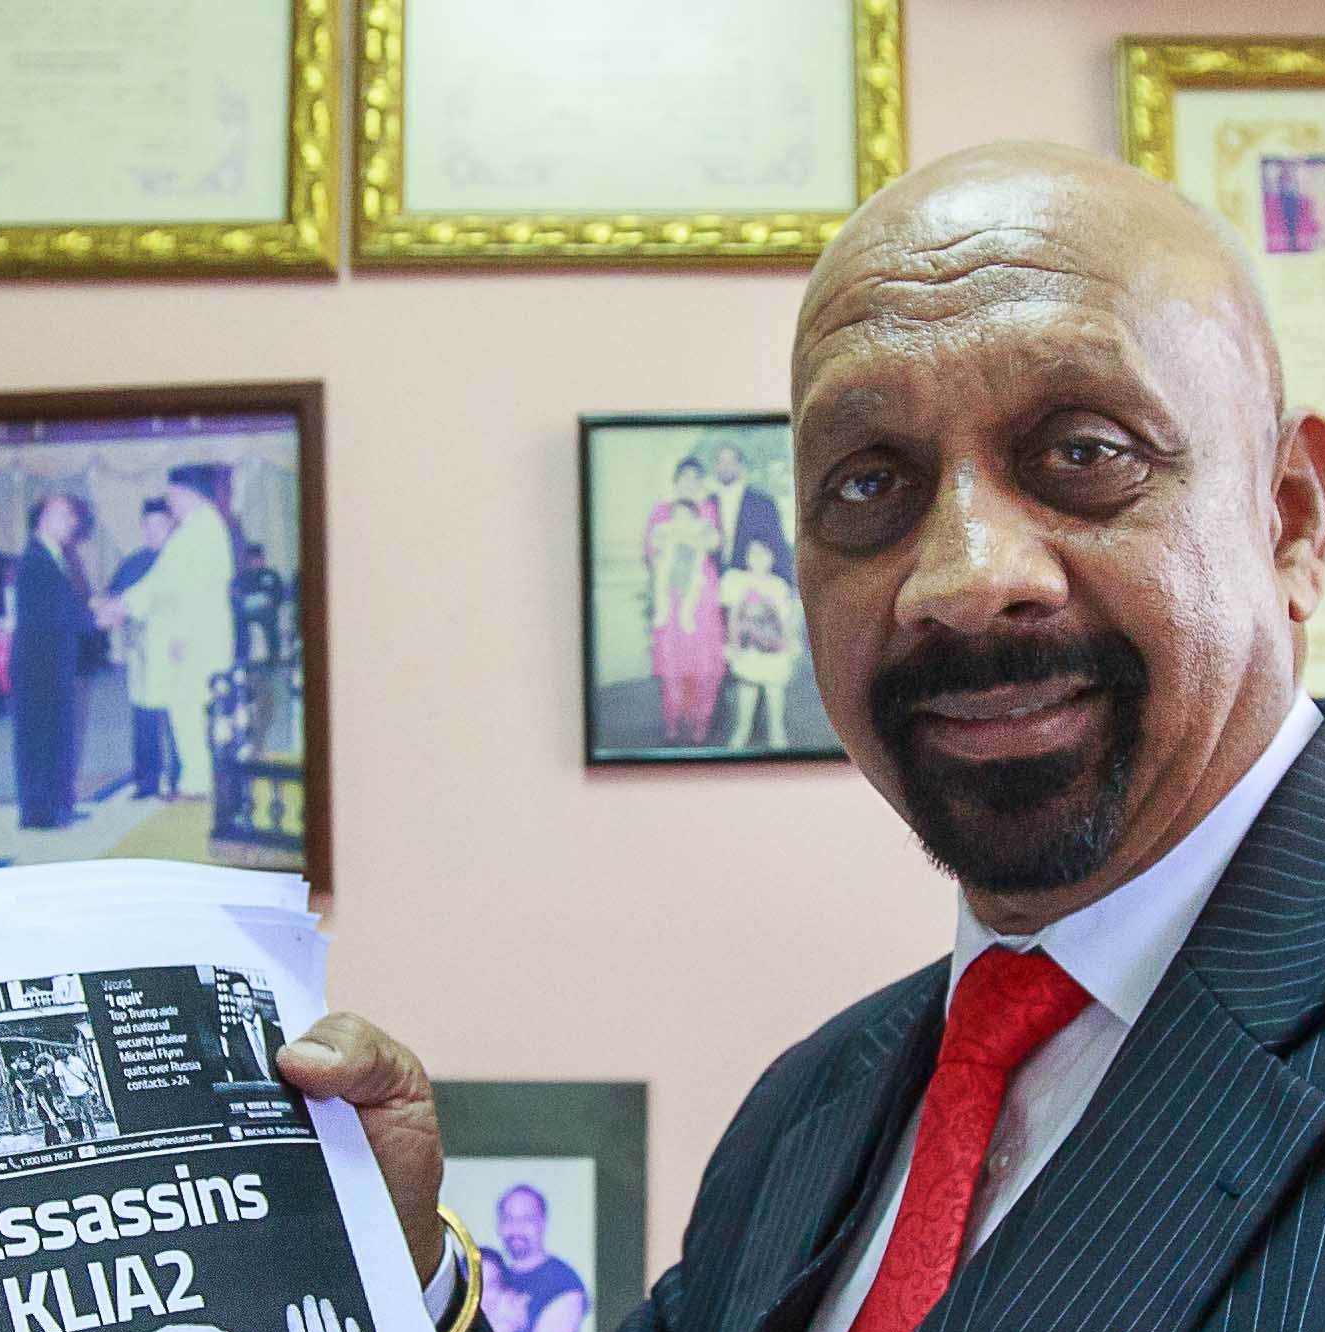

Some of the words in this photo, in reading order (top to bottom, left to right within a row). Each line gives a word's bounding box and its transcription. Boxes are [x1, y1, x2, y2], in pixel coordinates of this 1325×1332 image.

[108, 1010, 128, 1022] Top
[127, 1007, 158, 1019] Trump
[112, 1022, 132, 1035] and
[132, 1018, 170, 1033] national
[116, 1036, 154, 1049] security
[119, 1048, 157, 1063] Michael
[157, 1047, 184, 1060] Flynn
[123, 1065, 149, 1079] quits
[148, 1063, 170, 1074] over
[170, 1060, 202, 1072] Russia
